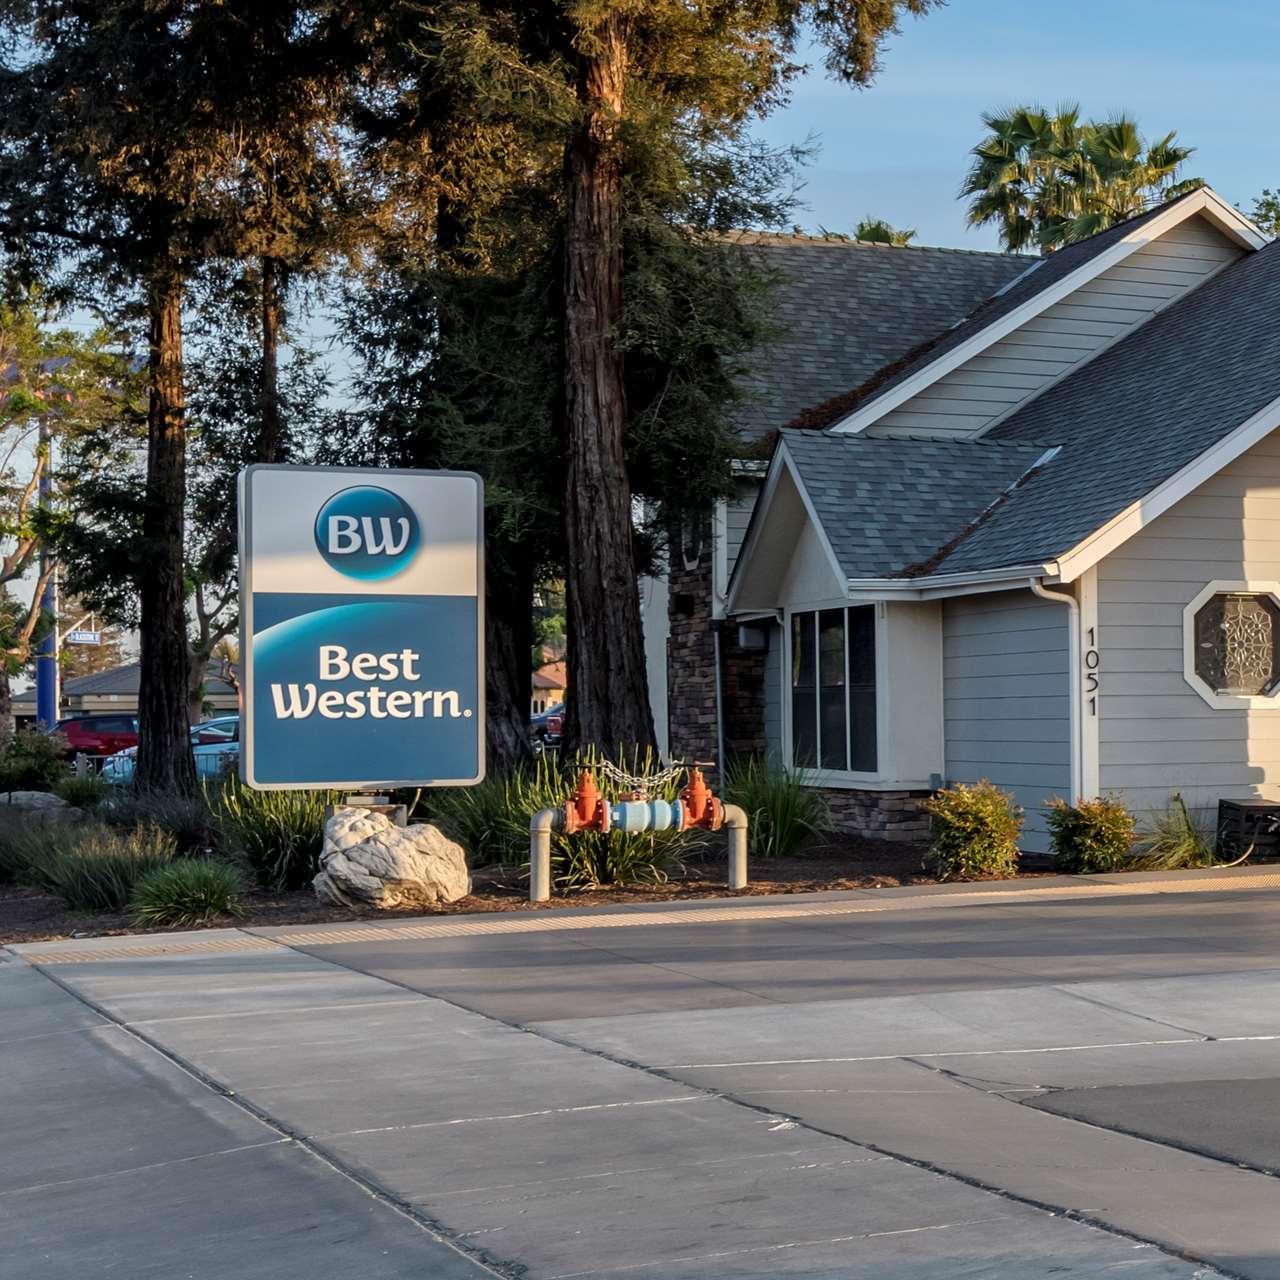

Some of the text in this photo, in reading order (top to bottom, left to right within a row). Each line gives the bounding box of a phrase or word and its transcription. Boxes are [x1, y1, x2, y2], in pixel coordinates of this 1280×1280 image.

[327, 514, 411, 556] BW
[319, 645, 421, 681] Best
[1085, 626, 1099, 717] 1051
[271, 683, 463, 719] Western
